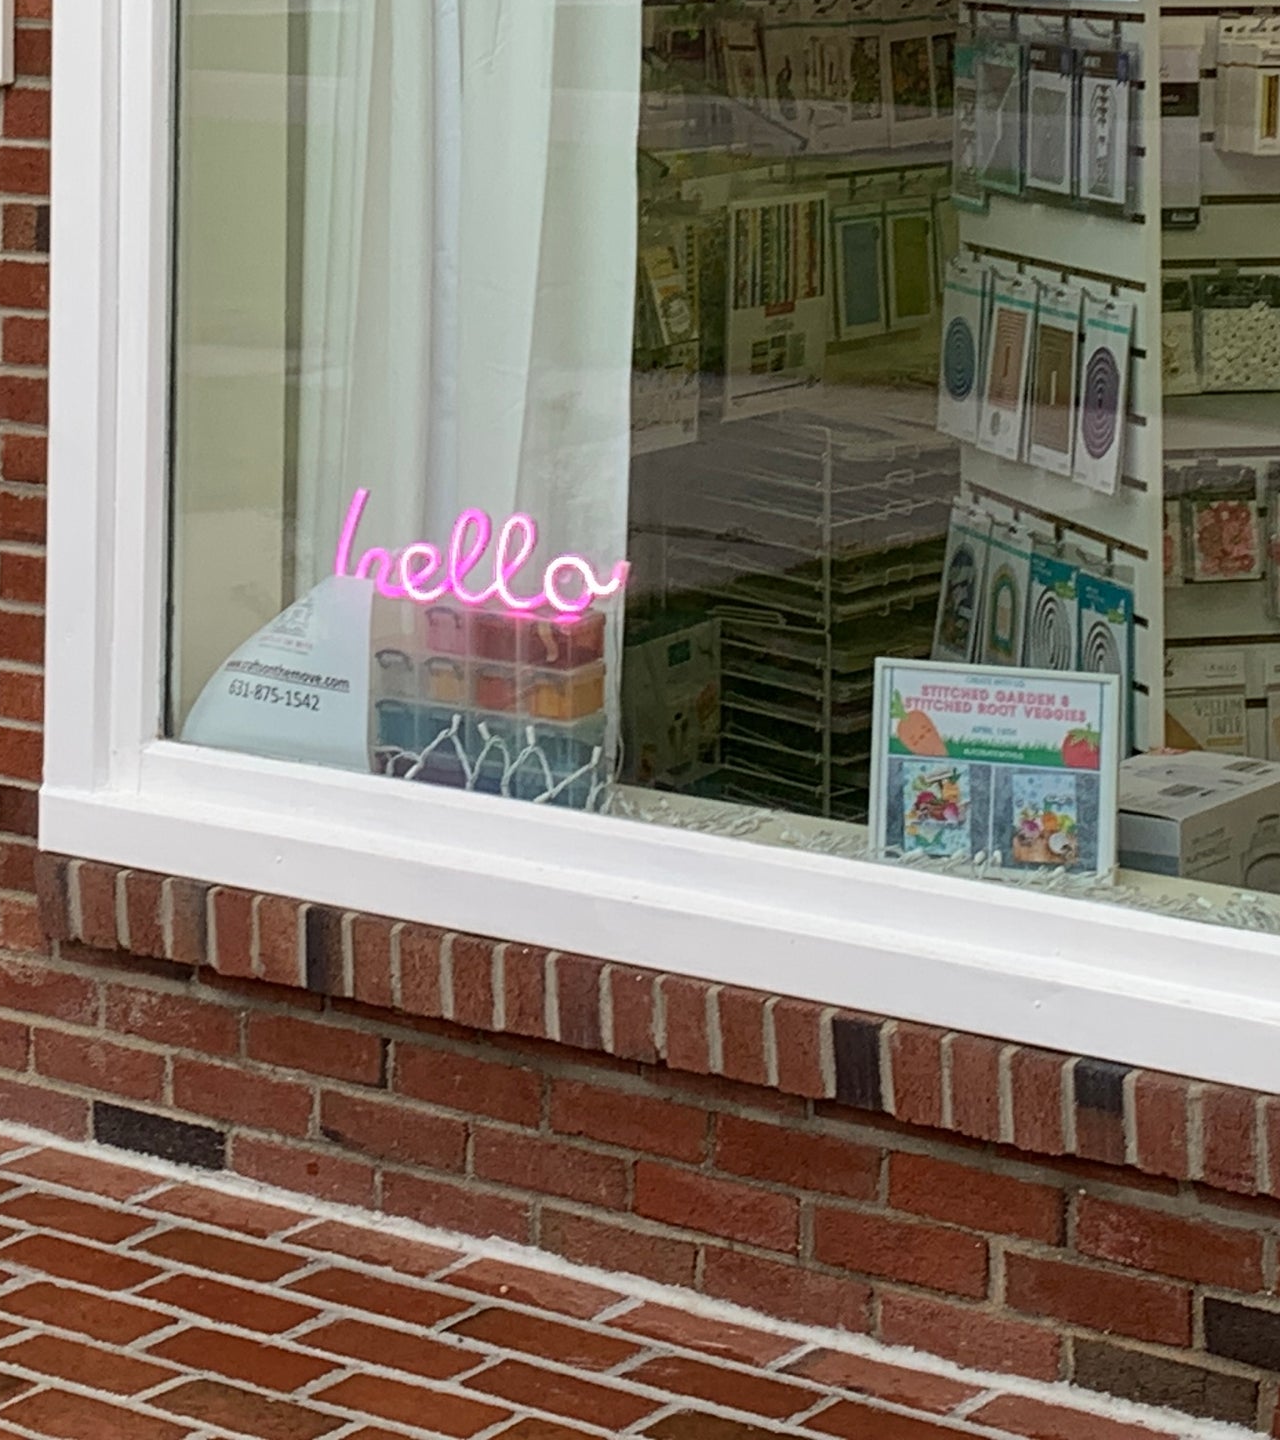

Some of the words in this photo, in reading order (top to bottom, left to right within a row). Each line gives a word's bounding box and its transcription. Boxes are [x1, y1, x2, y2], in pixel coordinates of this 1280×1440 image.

[333, 487, 631, 613] hello
[228, 678, 322, 713] 631-875-1542
[921, 685, 990, 700] STITCHED
[995, 690, 1056, 705] GARDEN
[904, 698, 973, 714] STITCHED
[977, 702, 1017, 717] ROOT
[1024, 707, 1088, 723] VEGGIES
